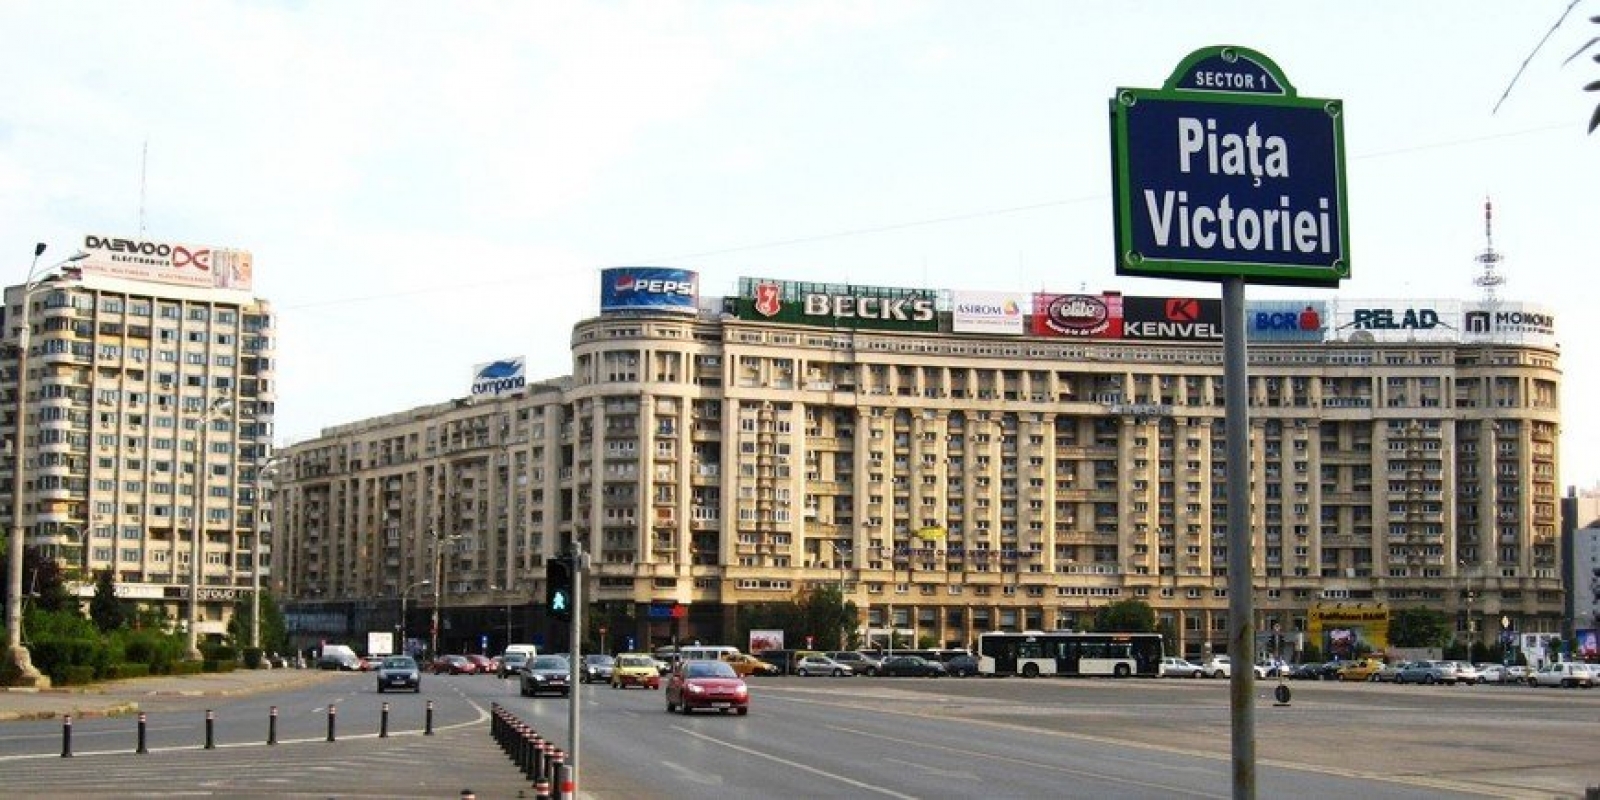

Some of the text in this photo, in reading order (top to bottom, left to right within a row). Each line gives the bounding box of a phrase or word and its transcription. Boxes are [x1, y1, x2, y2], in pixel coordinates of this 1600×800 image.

[1195, 71, 1267, 89] SECTOR 1
[1143, 188, 1332, 254] Victoriei
[85, 235, 170, 257] DAEWOO
[633, 279, 696, 296] PEPSI
[803, 292, 934, 321] BECK'S
[957, 304, 1002, 316] ASIROM
[1255, 312, 1299, 331] BCR
[1353, 309, 1440, 330] RELAD
[1123, 321, 1224, 338] KENVEL
